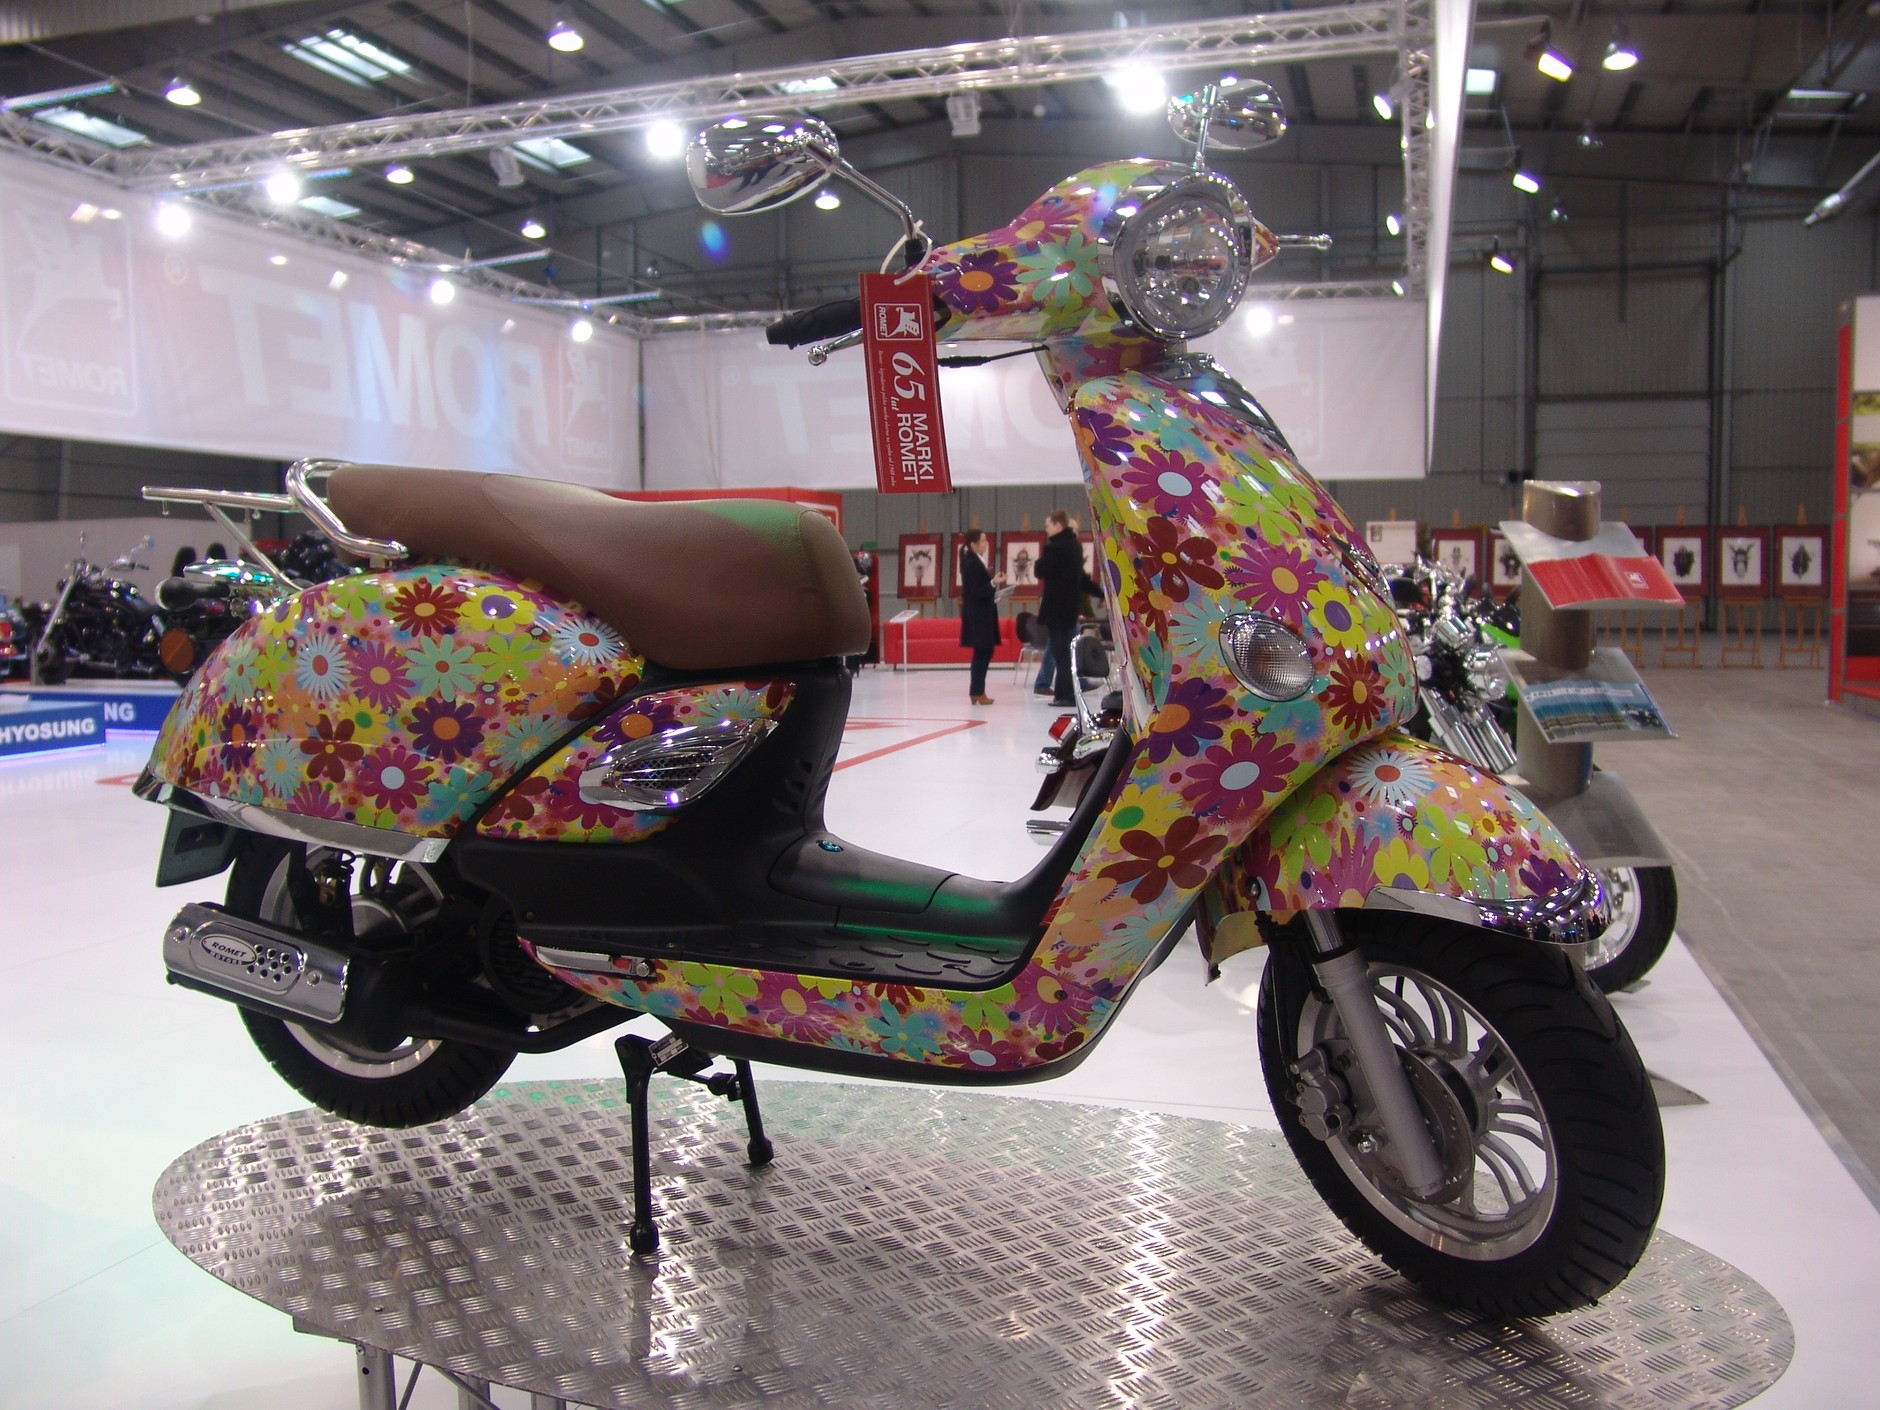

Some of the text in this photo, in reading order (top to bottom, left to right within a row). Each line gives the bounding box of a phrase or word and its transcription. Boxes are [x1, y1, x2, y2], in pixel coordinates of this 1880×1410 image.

[878, 306, 888, 337] ROMET
[892, 351, 926, 401] 65
[890, 397, 900, 411] lat
[897, 413, 919, 485] ROMET
[912, 413, 934, 480] MARKI
[0, 718, 95, 744] HYOSUNG
[211, 941, 247, 958] ROMET
